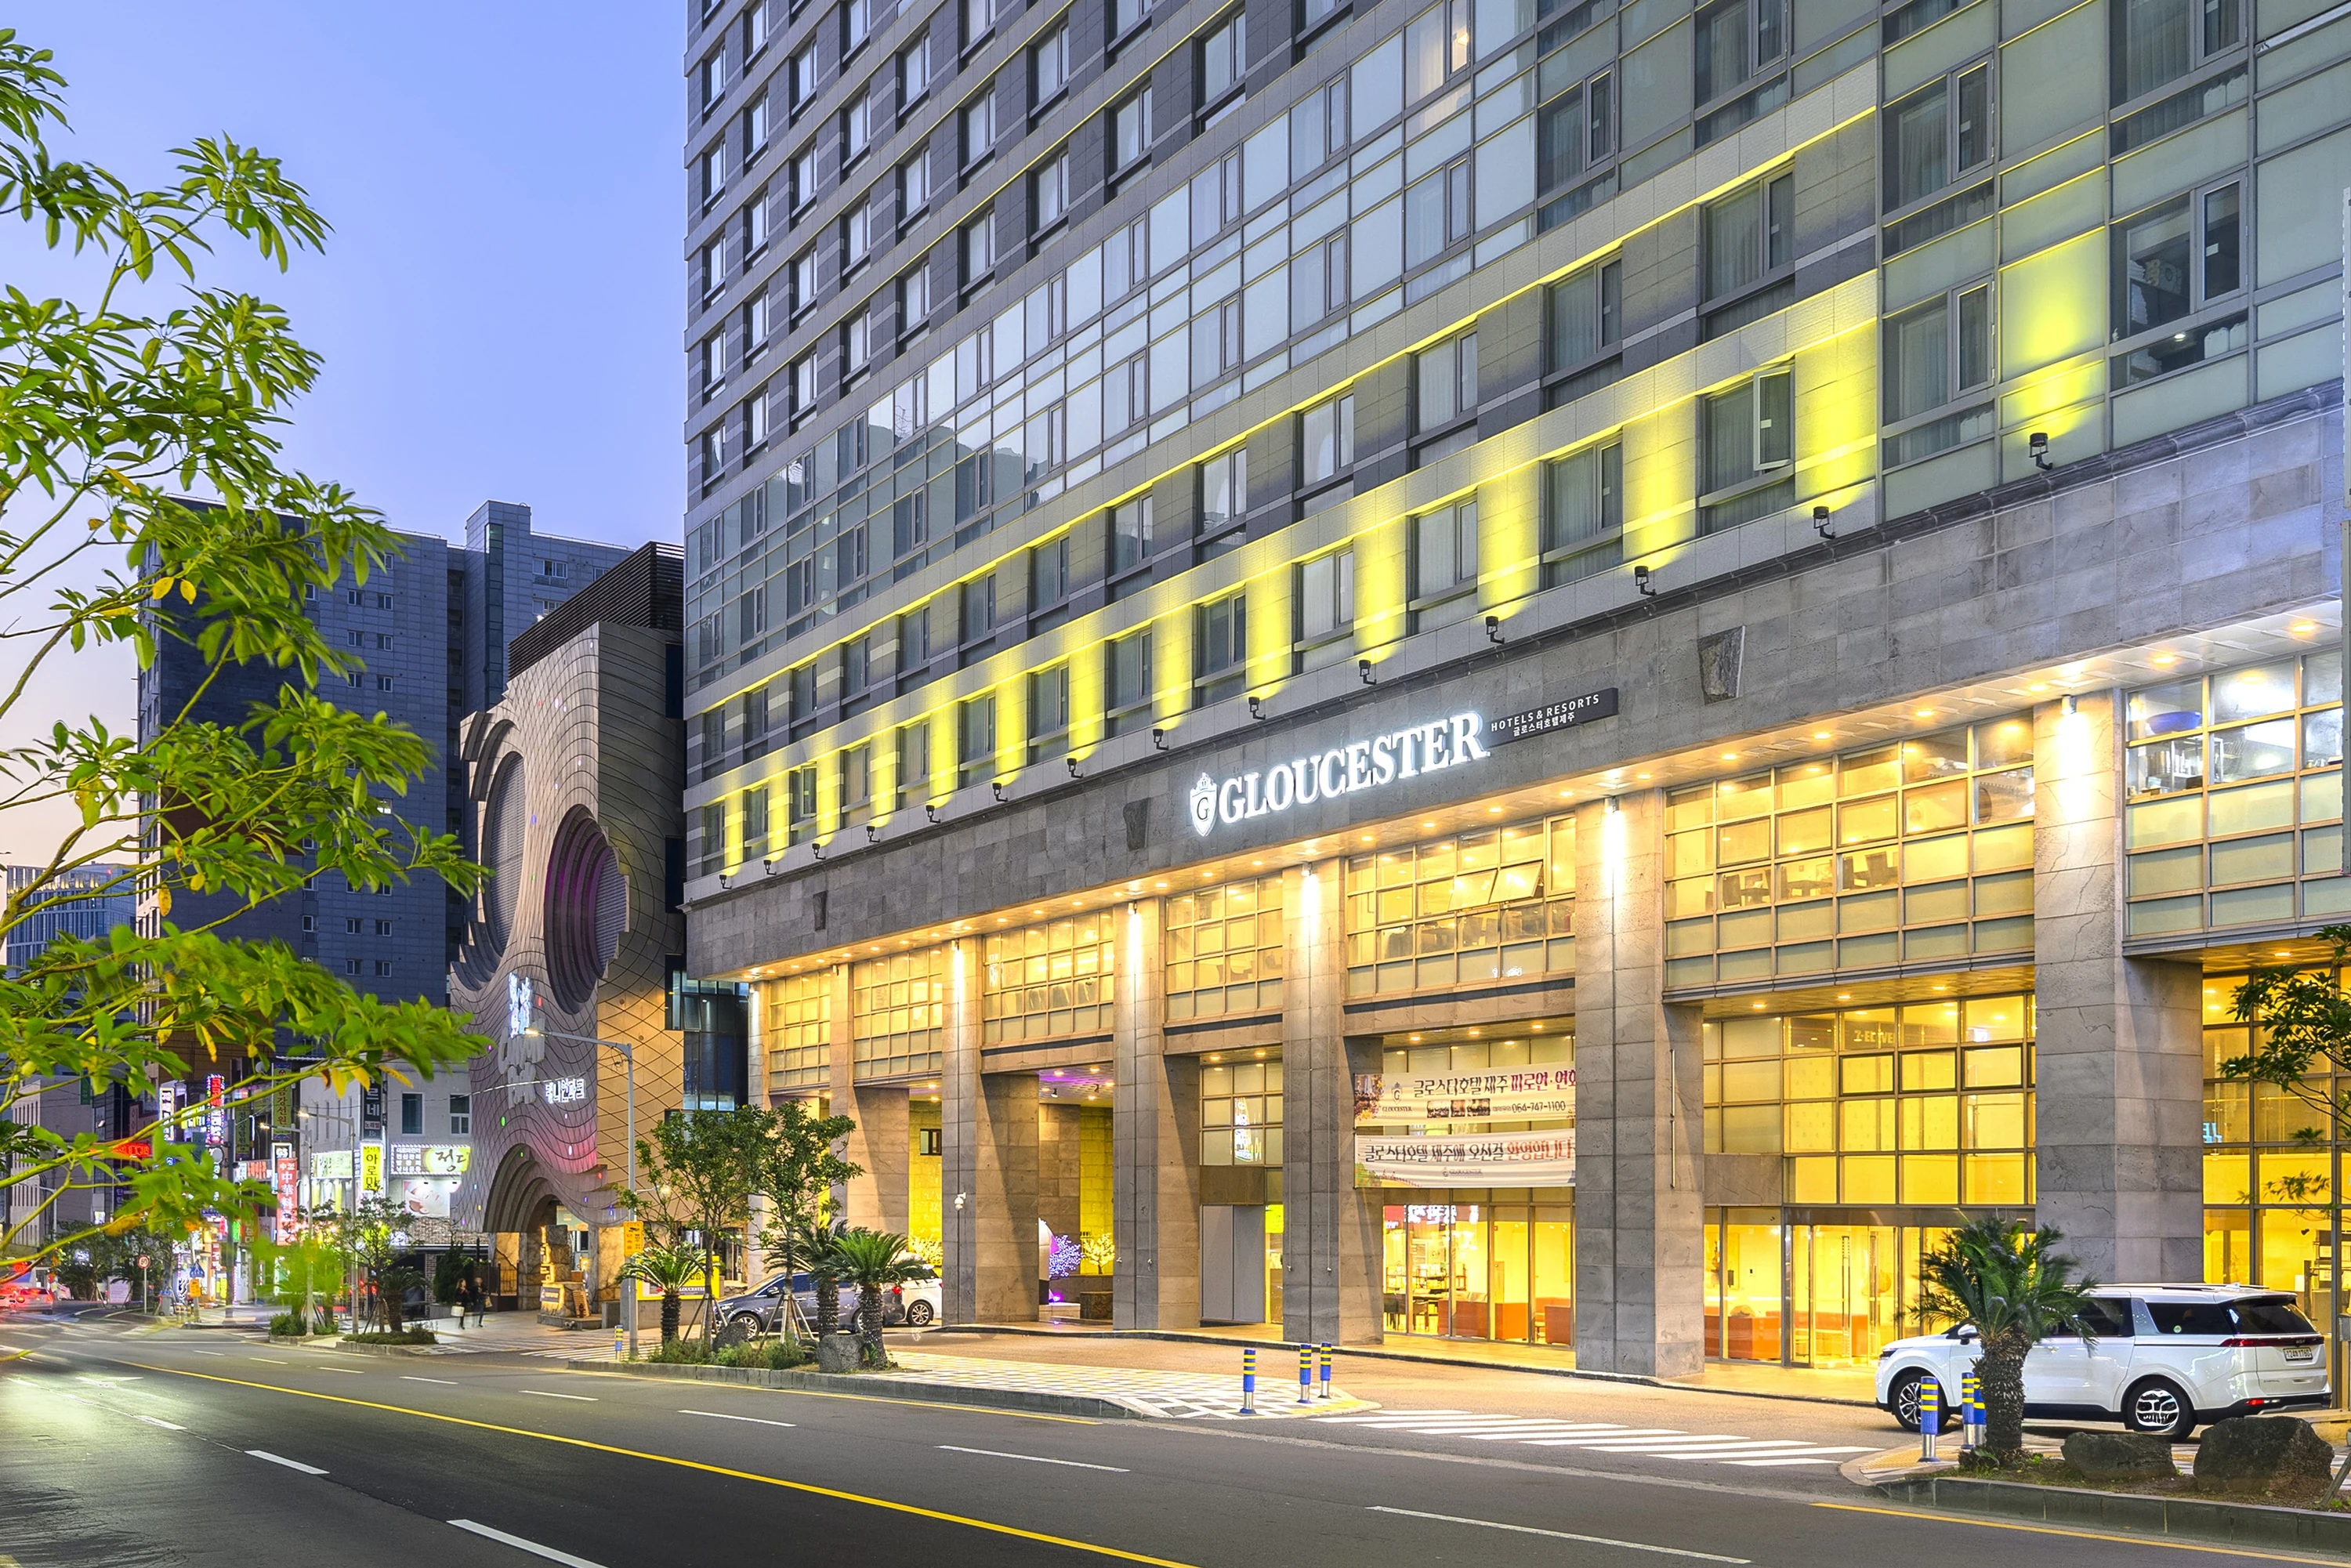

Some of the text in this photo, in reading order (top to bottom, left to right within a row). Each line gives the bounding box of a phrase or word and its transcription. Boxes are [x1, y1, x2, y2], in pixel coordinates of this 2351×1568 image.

[1491, 694, 1599, 732] HOTELS & RESORTS
[1218, 710, 1491, 824] GLOUCESTER
[1196, 797, 1209, 820] G
[1394, 1090, 1400, 1100] G
[1512, 1101, 1566, 1113] 064-747-1100
[1469, 1143, 1504, 1162] 오신걸
[1506, 1139, 1574, 1161] 환영합니다
